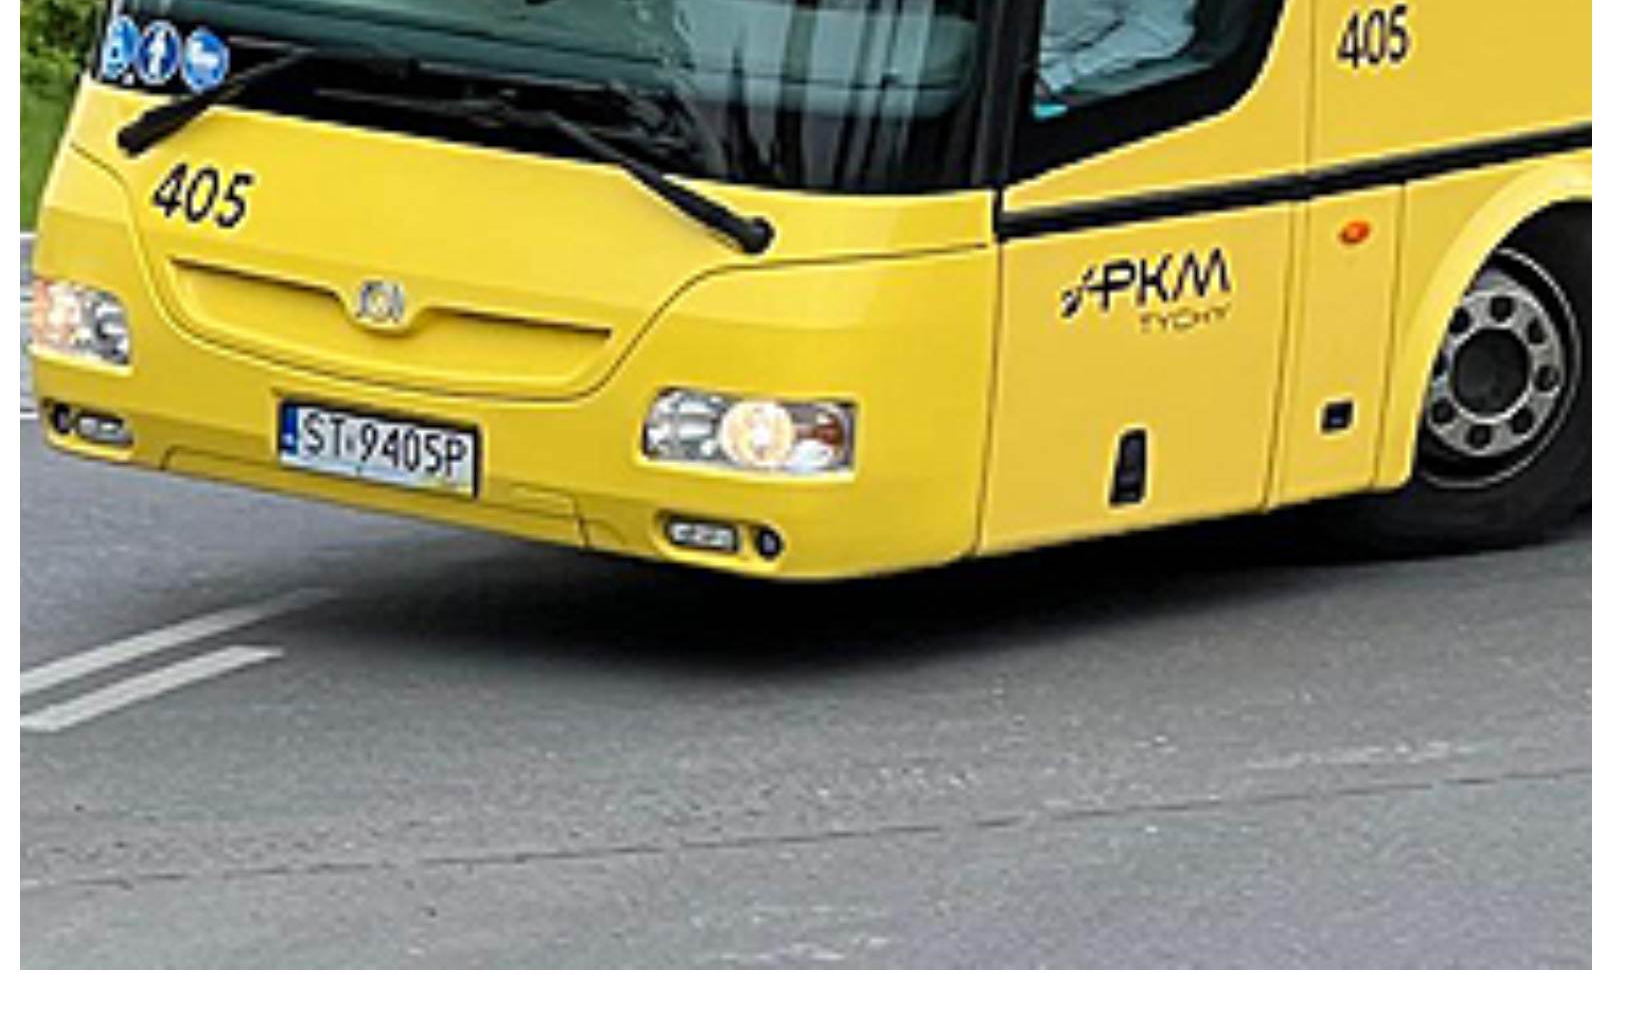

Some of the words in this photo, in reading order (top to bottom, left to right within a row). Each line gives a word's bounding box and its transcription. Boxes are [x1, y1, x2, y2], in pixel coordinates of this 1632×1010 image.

[1337, 3, 1410, 71] 405
[151, 162, 255, 229] 405
[1092, 246, 1232, 312] PKM
[1138, 302, 1233, 334] TYCHY
[303, 411, 347, 457] ST
[360, 422, 468, 477] 9405P
